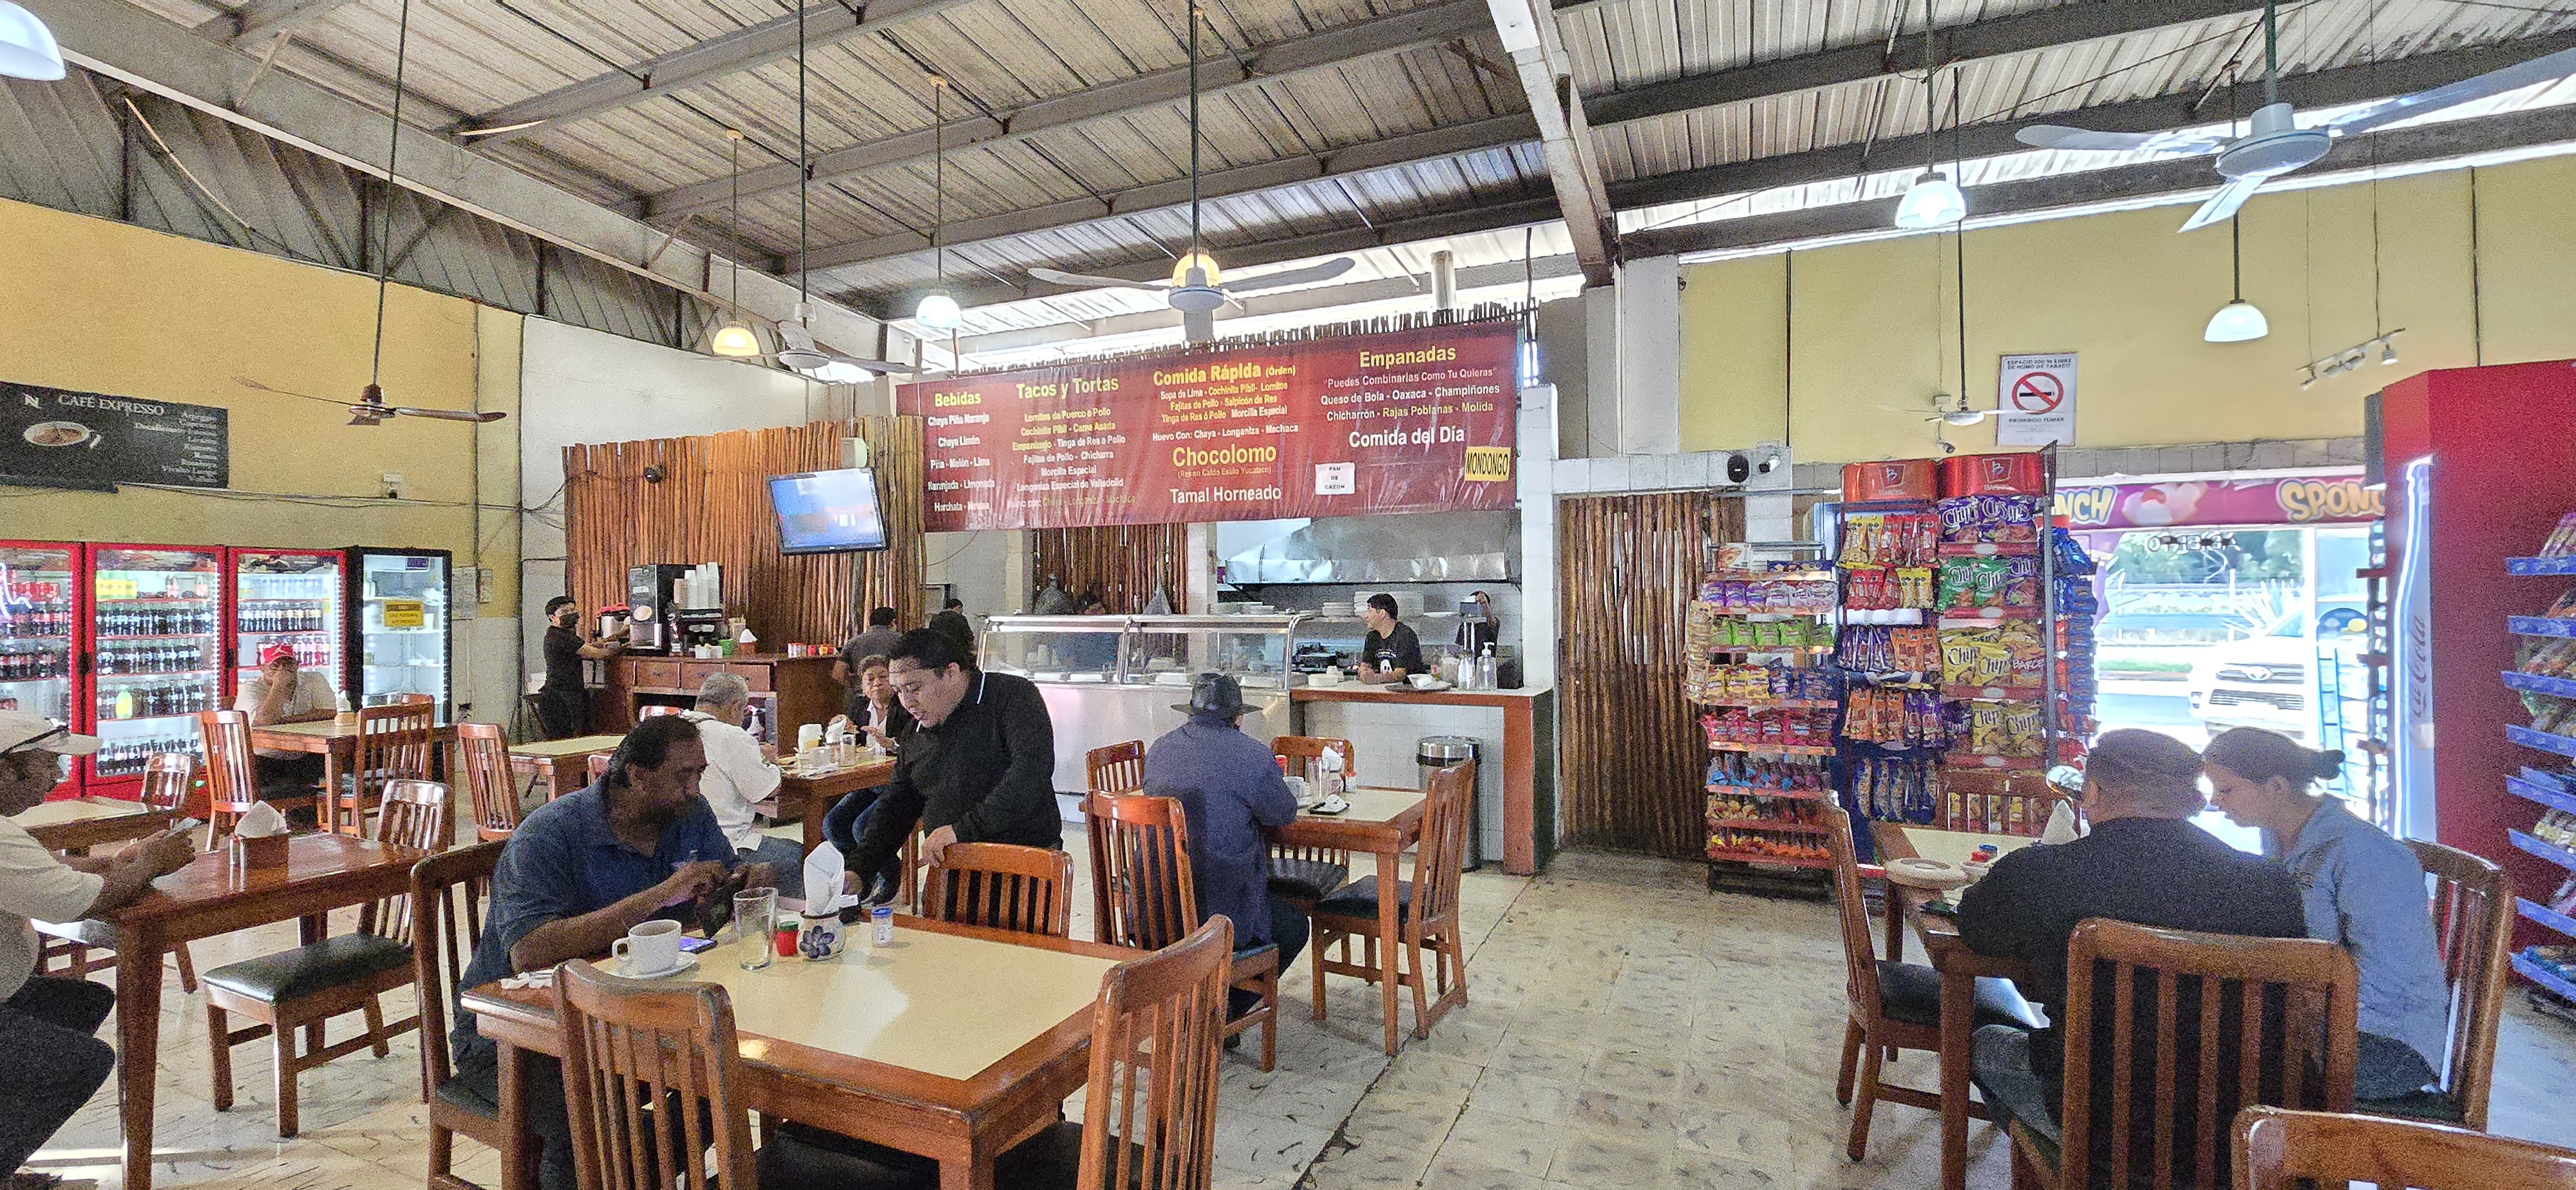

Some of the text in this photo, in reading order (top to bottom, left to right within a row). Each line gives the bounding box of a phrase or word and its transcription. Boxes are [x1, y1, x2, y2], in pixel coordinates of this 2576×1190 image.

[1359, 346, 1457, 369] Empanadas
[1153, 368, 1207, 386] Comida
[1211, 363, 1262, 382] Rápida
[1362, 372, 1419, 386] Combinarlas
[1421, 371, 1446, 381] Como
[1448, 369, 1457, 379] Tu
[1016, 377, 1119, 400] Tacos y Tortas
[1160, 390, 1177, 401] Sopa
[1177, 389, 1186, 399] de
[1187, 388, 1203, 398] Lima
[1208, 384, 1239, 396] Cochinita
[1260, 381, 1287, 392] Lomitos
[1320, 384, 1500, 406] Queso de Bola Oaxaca Champiñones
[59, 395, 165, 416] CAFÉ EXPRESSO
[935, 392, 981, 407] Bebidas
[1170, 394, 1278, 412] Fajitas de Pollo Salpicón de Res
[1052, 411, 1061, 420] de
[1062, 410, 1086, 420] Puerco
[1093, 407, 1112, 417] Pollo
[1161, 414, 1179, 424] Tinga
[1180, 413, 1189, 421] de
[1189, 412, 1202, 420] Res
[1209, 410, 1227, 419] Pollo
[1231, 408, 1258, 418] Morcilla
[1259, 405, 1287, 417] Especial
[1326, 401, 1493, 421] Chicharrón Rajas Poblanas Molida
[1094, 421, 1115, 431] Asada
[1152, 432, 1174, 442] Huevo
[1194, 428, 1217, 440] Chaya
[1222, 426, 1260, 438] Longaniza
[1265, 424, 1299, 435] Machaca
[1057, 437, 1076, 449] Tinga
[1077, 437, 1086, 446] de
[1086, 436, 1101, 445] Res
[1107, 435, 1126, 444] Pollo
[1349, 425, 1465, 448] Comida del Día
[1046, 453, 1056, 462] de
[1056, 452, 1074, 462] Pollo
[1173, 444, 1277, 467] Chocolomo
[1466, 452, 1508, 475] MONDONGO
[1041, 465, 1097, 477] Morcilla Especial
[1202, 468, 1220, 477] Caldo
[1051, 480, 1079, 491] Especial
[1080, 480, 1089, 489] de
[1090, 478, 1124, 489] Valladolid
[1170, 484, 1282, 504] Tamal Horneado
